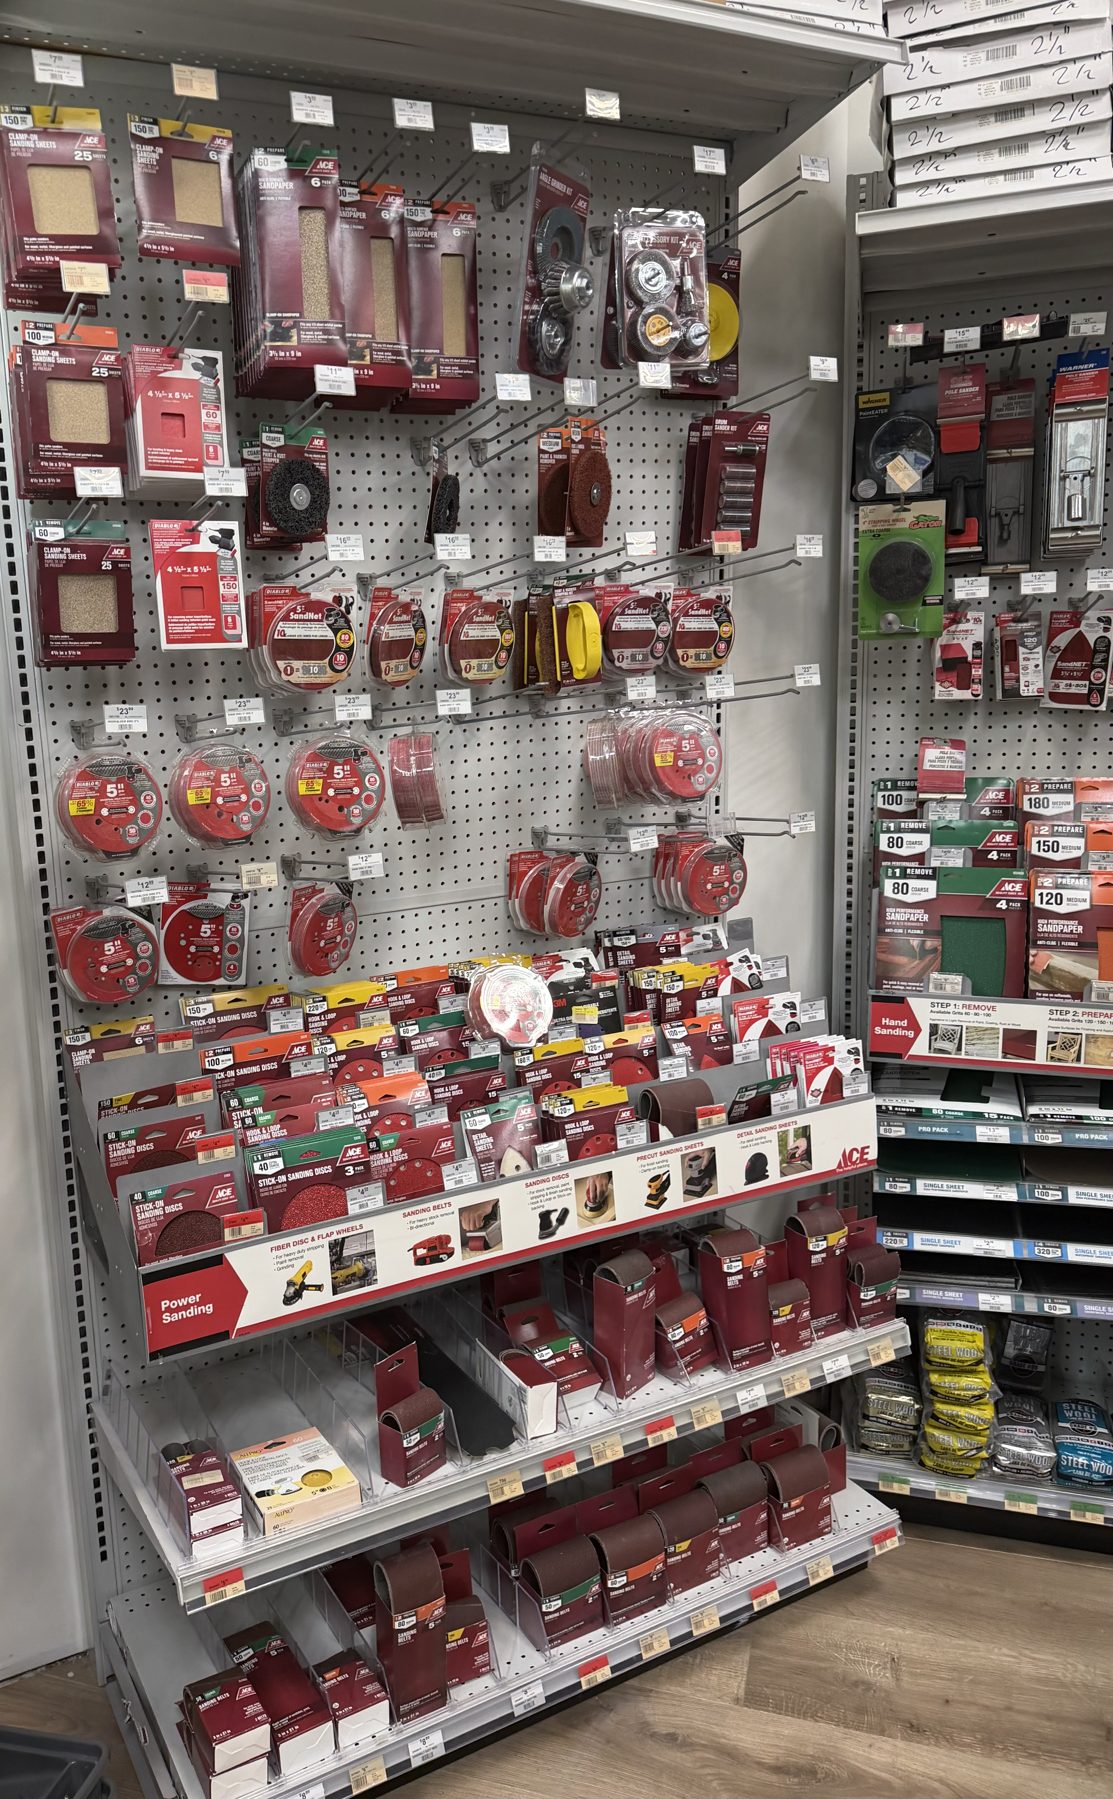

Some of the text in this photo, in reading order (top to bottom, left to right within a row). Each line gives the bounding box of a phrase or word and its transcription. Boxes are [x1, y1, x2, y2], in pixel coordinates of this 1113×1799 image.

[4, 116, 19, 125] 150
[134, 125, 147, 133] 150
[9, 140, 56, 149] SANDING SHEETS
[74, 151, 92, 161] 25
[209, 151, 217, 160] 6
[258, 157, 268, 167] 60
[316, 160, 334, 169] ACE
[311, 177, 321, 187] 6
[405, 207, 419, 216] 150
[453, 228, 461, 236] 6
[27, 332, 41, 340] 100
[1059, 363, 1094, 372] WARNER
[91, 368, 108, 377] 25
[862, 397, 887, 405] WAGNER
[312, 438, 324, 446] ACE
[38, 529, 48, 537] 60
[102, 561, 112, 570] 25
[290, 612, 322, 620] SandNet
[986, 791, 1005, 799] ACE
[881, 794, 903, 806] 100
[1027, 797, 1050, 809] 180
[980, 807, 991, 815] 4
[887, 836, 903, 848] 80
[992, 834, 1012, 843] ACE
[1036, 840, 1059, 853] 150
[1057, 878, 1088, 886] PREPARE
[892, 882, 909, 895] 80
[1001, 883, 1023, 892] ACE
[1037, 892, 1063, 906] 120
[996, 900, 1007, 909] 4
[886, 913, 929, 922] SANDPAPER
[1037, 924, 1083, 934] SANDPAPER
[664, 983, 676, 991] 150
[553, 998, 566, 1008] 3M
[188, 1007, 201, 1015] 150
[962, 1004, 997, 1012] REMOVE
[881, 1018, 907, 1027] Hand
[874, 1026, 914, 1038] Sanding
[586, 1043, 597, 1051] 120
[207, 1058, 220, 1067] 100
[236, 1062, 278, 1076] SANDING DISCS
[557, 1107, 567, 1115] 120
[517, 1123, 525, 1131] 5
[565, 1122, 576, 1130] HOOK
[755, 1125, 775, 1135] SANDING
[777, 1120, 798, 1129] SHEETS
[566, 1127, 582, 1135] SANDING
[109, 1143, 154, 1157] SANDING DISCS
[346, 1146, 362, 1157] ACE
[636, 1141, 704, 1162] PRECUT SANDING SHEETS
[835, 1145, 870, 1170] ACE
[258, 1163, 268, 1171] 40
[345, 1167, 354, 1175] 3
[258, 1166, 332, 1187] STICK-ON SANDING DISCS
[525, 1173, 570, 1188] SANDING DISCS
[216, 1189, 233, 1199] ACE
[1036, 1190, 1050, 1198] 100
[136, 1200, 164, 1212] STICK-ON
[402, 1201, 452, 1219] SANDING BELTS
[137, 1203, 183, 1220] SANDING DISCS
[270, 1243, 292, 1253] FIBER
[292, 1239, 309, 1248] DISC
[317, 1232, 334, 1242] FLAP
[336, 1224, 364, 1237] WHEELS
[727, 1274, 743, 1282] SANDING
[922, 1289, 943, 1297] SINGLE
[161, 1293, 202, 1311] Power
[162, 1301, 214, 1324] Sanding
[1063, 1403, 1095, 1413] STEEL
[1064, 1409, 1095, 1422] WOOL
[398, 1630, 417, 1638] SANDING
[398, 1635, 411, 1643] BELTS
[199, 1693, 230, 1709] SANDING BELTS
